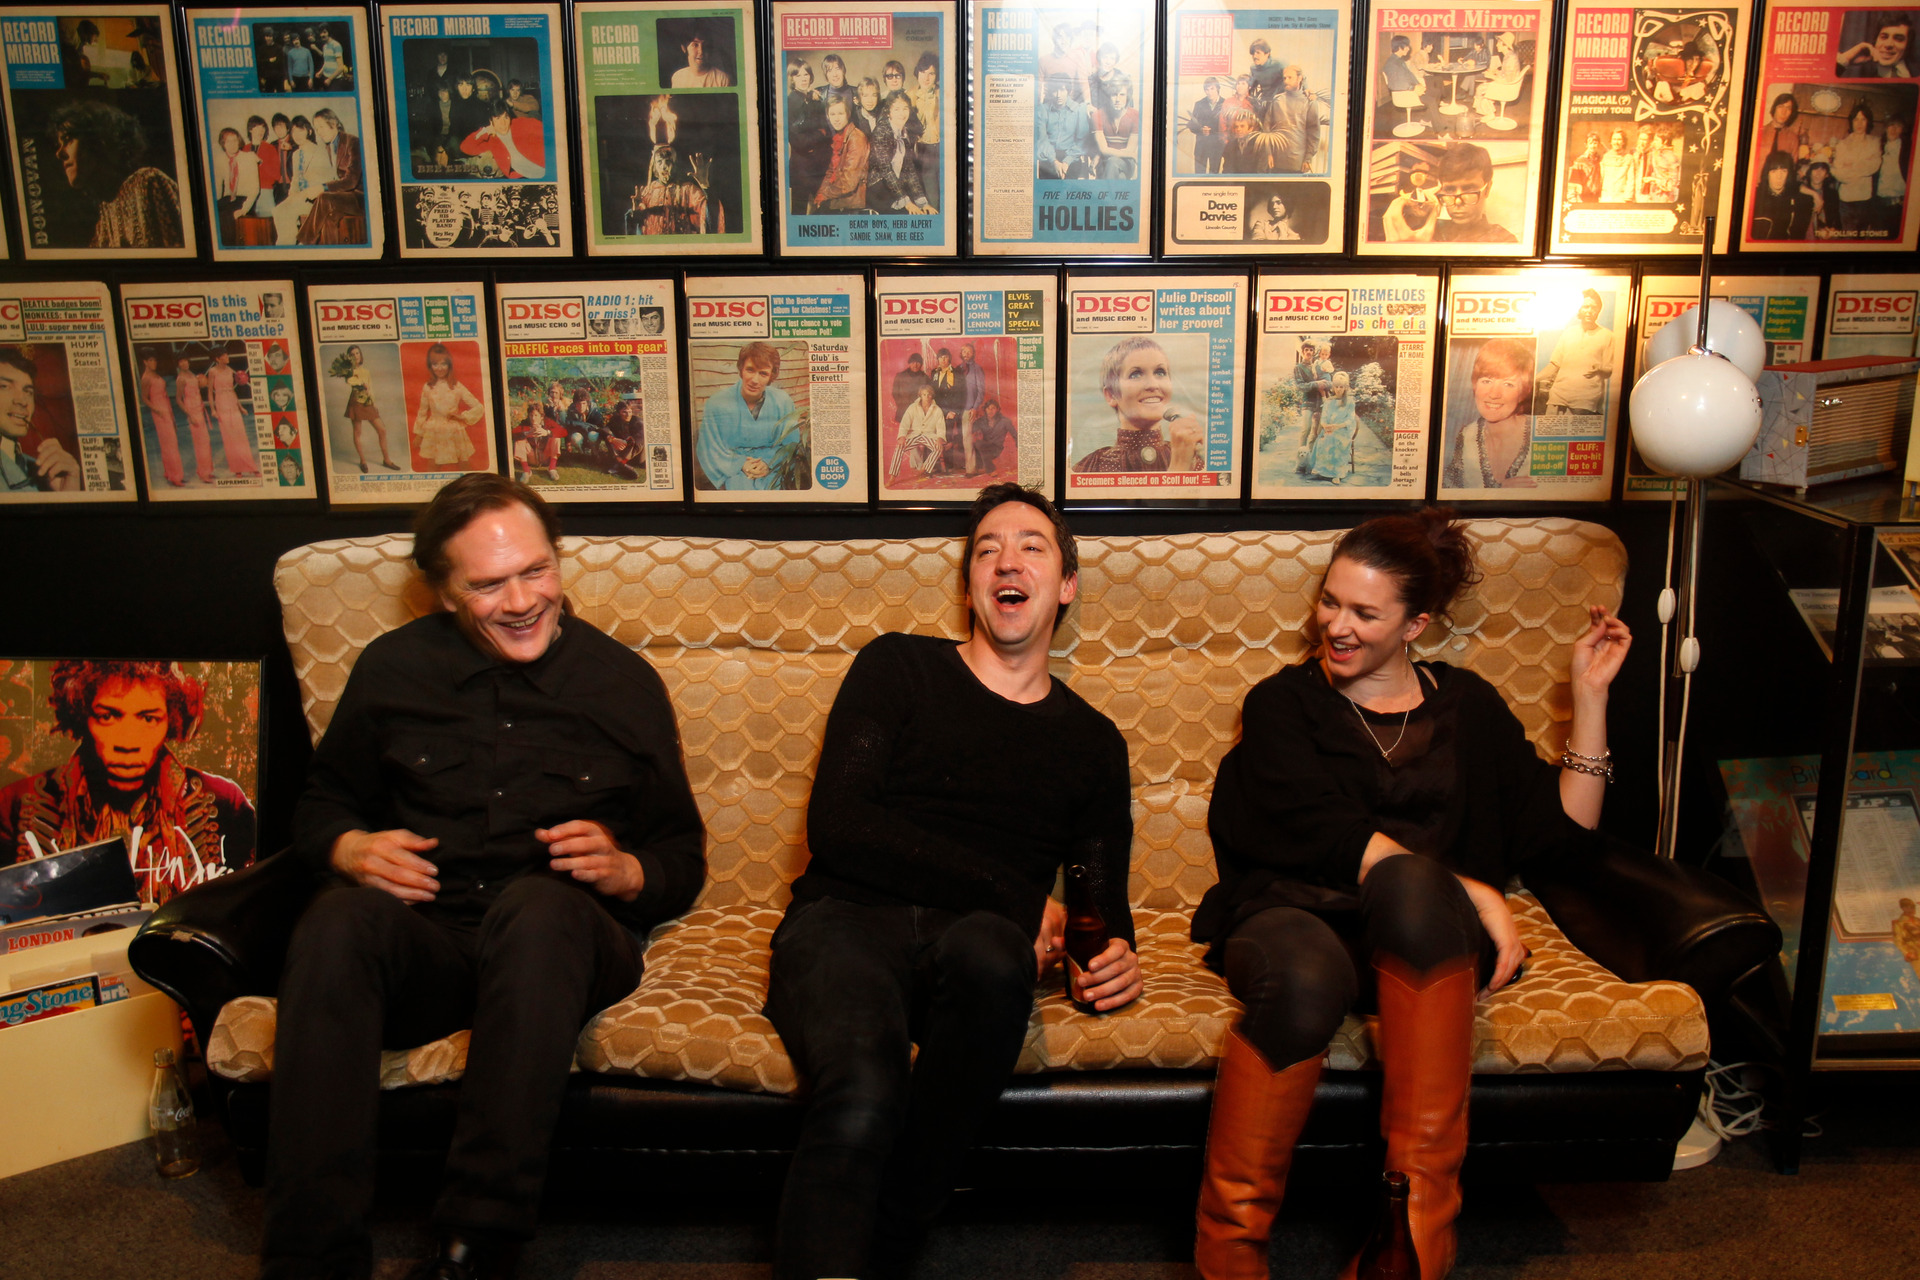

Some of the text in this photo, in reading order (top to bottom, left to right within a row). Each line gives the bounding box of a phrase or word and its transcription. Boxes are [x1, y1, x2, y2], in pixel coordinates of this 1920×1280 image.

[392, 17, 439, 36] RECORD
[443, 16, 491, 35] MIRROR
[988, 11, 1033, 30] RECORD
[1382, 9, 1536, 29] Record Mirror
[1576, 13, 1630, 34] RECORD
[1776, 11, 1830, 32] RECORD
[3, 22, 56, 42] RECORD
[786, 17, 887, 37] RECORD MIRROR
[1183, 17, 1230, 37] RECORD
[198, 25, 251, 46] RECORD
[591, 24, 639, 45] RECORD
[987, 33, 1033, 51] MIRROR
[1182, 37, 1229, 56] MIRROR
[1574, 37, 1629, 58] MIRROR
[1773, 33, 1828, 55] MIRROR
[7, 43, 60, 64] MIRROR
[200, 47, 254, 68] MIRROR
[592, 45, 641, 65] MIRROR
[1570, 106, 1633, 114] MYSTERY TOUR
[1043, 191, 1130, 200] FIVE YEARS OF THE
[1208, 200, 1238, 211] Dave
[1039, 205, 1134, 232] HOLLIES
[1200, 211, 1237, 222] Davies
[798, 224, 840, 238] INSIDE:
[849, 219, 933, 230] BEACH BOYS, HERB ALPERT
[849, 231, 924, 242] SANDIE SHAW, BEE GEES
[207, 294, 247, 308] Is this
[587, 294, 654, 306] RADIO hit
[1007, 293, 1032, 301] ELVIS:
[1159, 291, 1233, 303] Julie Driscoll
[1352, 289, 1425, 301] TREMELOES
[23, 299, 78, 309] BEATLE badges
[692, 302, 765, 318] DISC
[884, 297, 958, 316] DISC
[1007, 302, 1034, 310] GREAT
[1076, 296, 1150, 313] DISC
[1159, 305, 1231, 316] writes about
[1269, 295, 1344, 312] DISC
[1351, 303, 1383, 316] blast
[1837, 296, 1913, 313] DISC
[24, 312, 63, 320] MONKEES:
[64, 311, 78, 319] fan
[80, 311, 101, 319] fever
[131, 302, 202, 320] DISC
[210, 310, 261, 323] man the
[321, 304, 393, 322] DISC
[508, 303, 581, 320] DISC
[587, 311, 600, 319] or
[1008, 311, 1019, 319] TV
[26, 323, 48, 331] LULU:
[49, 323, 70, 332] super
[89, 322, 105, 330] disc
[211, 323, 284, 338] 5th Beatle?
[1007, 320, 1041, 328] SPECIAL
[1159, 317, 1224, 331] her groove!
[70, 341, 99, 349] HUMP
[505, 340, 668, 355] TRAFFIC races into top gear!
[832, 354, 839, 362] is
[811, 374, 844, 382] Everett!
[1395, 433, 1419, 441] JAGGER
[825, 458, 839, 466] BIG
[1532, 453, 1565, 462] big tour
[1581, 462, 1590, 470] to
[1076, 475, 1199, 486] Screamers silenced on Scott tour!
[8, 928, 74, 951] LONDON
